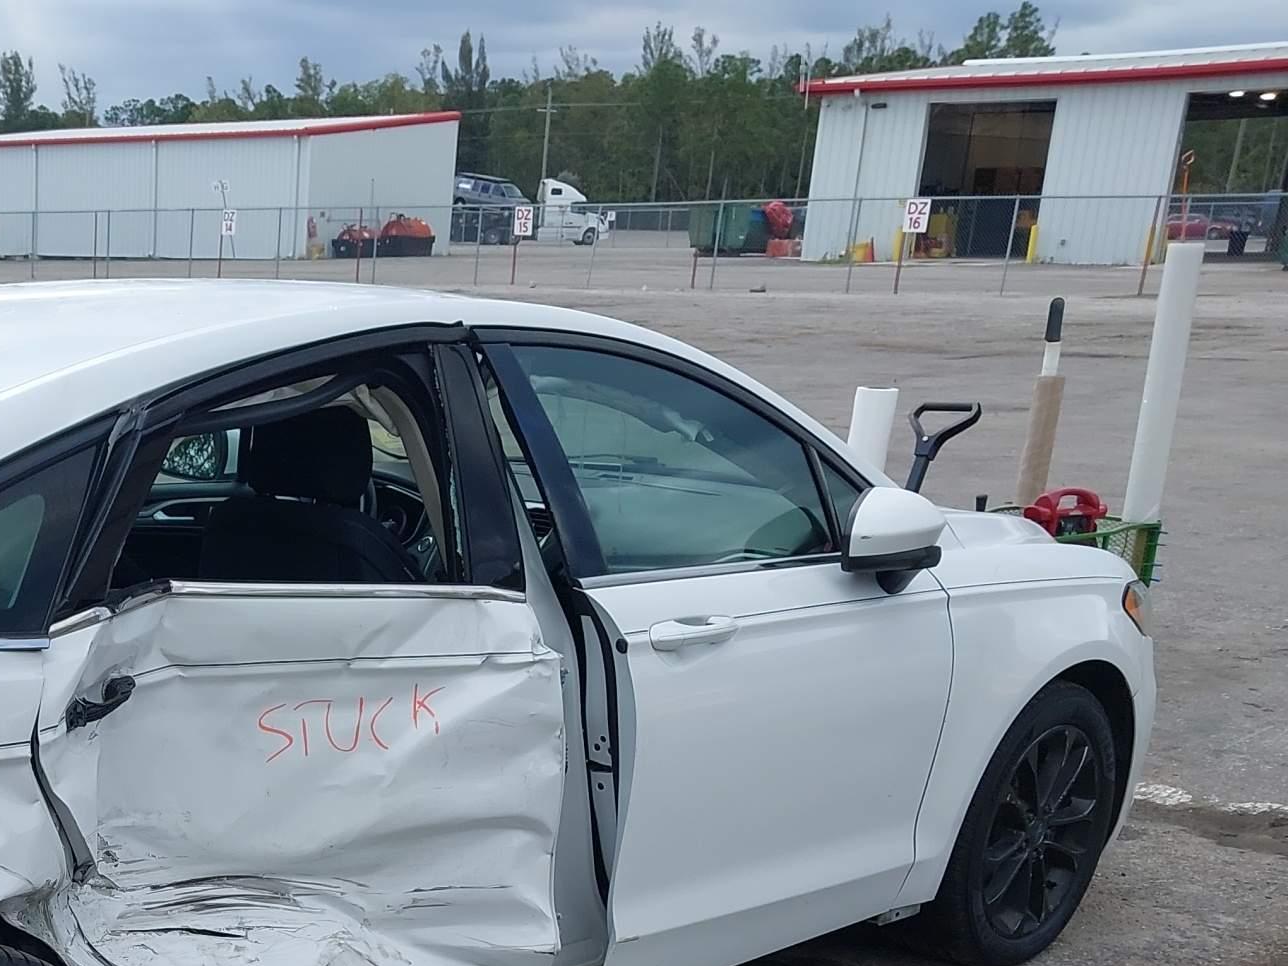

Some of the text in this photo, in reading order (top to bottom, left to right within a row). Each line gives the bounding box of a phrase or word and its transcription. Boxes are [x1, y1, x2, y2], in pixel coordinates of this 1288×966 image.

[517, 208, 532, 221] DZ
[907, 201, 929, 215] DZ
[223, 211, 236, 222] DZ
[908, 216, 921, 230] 16
[225, 222, 233, 233] 14
[518, 221, 529, 233] 15
[258, 683, 446, 763] STUCK
